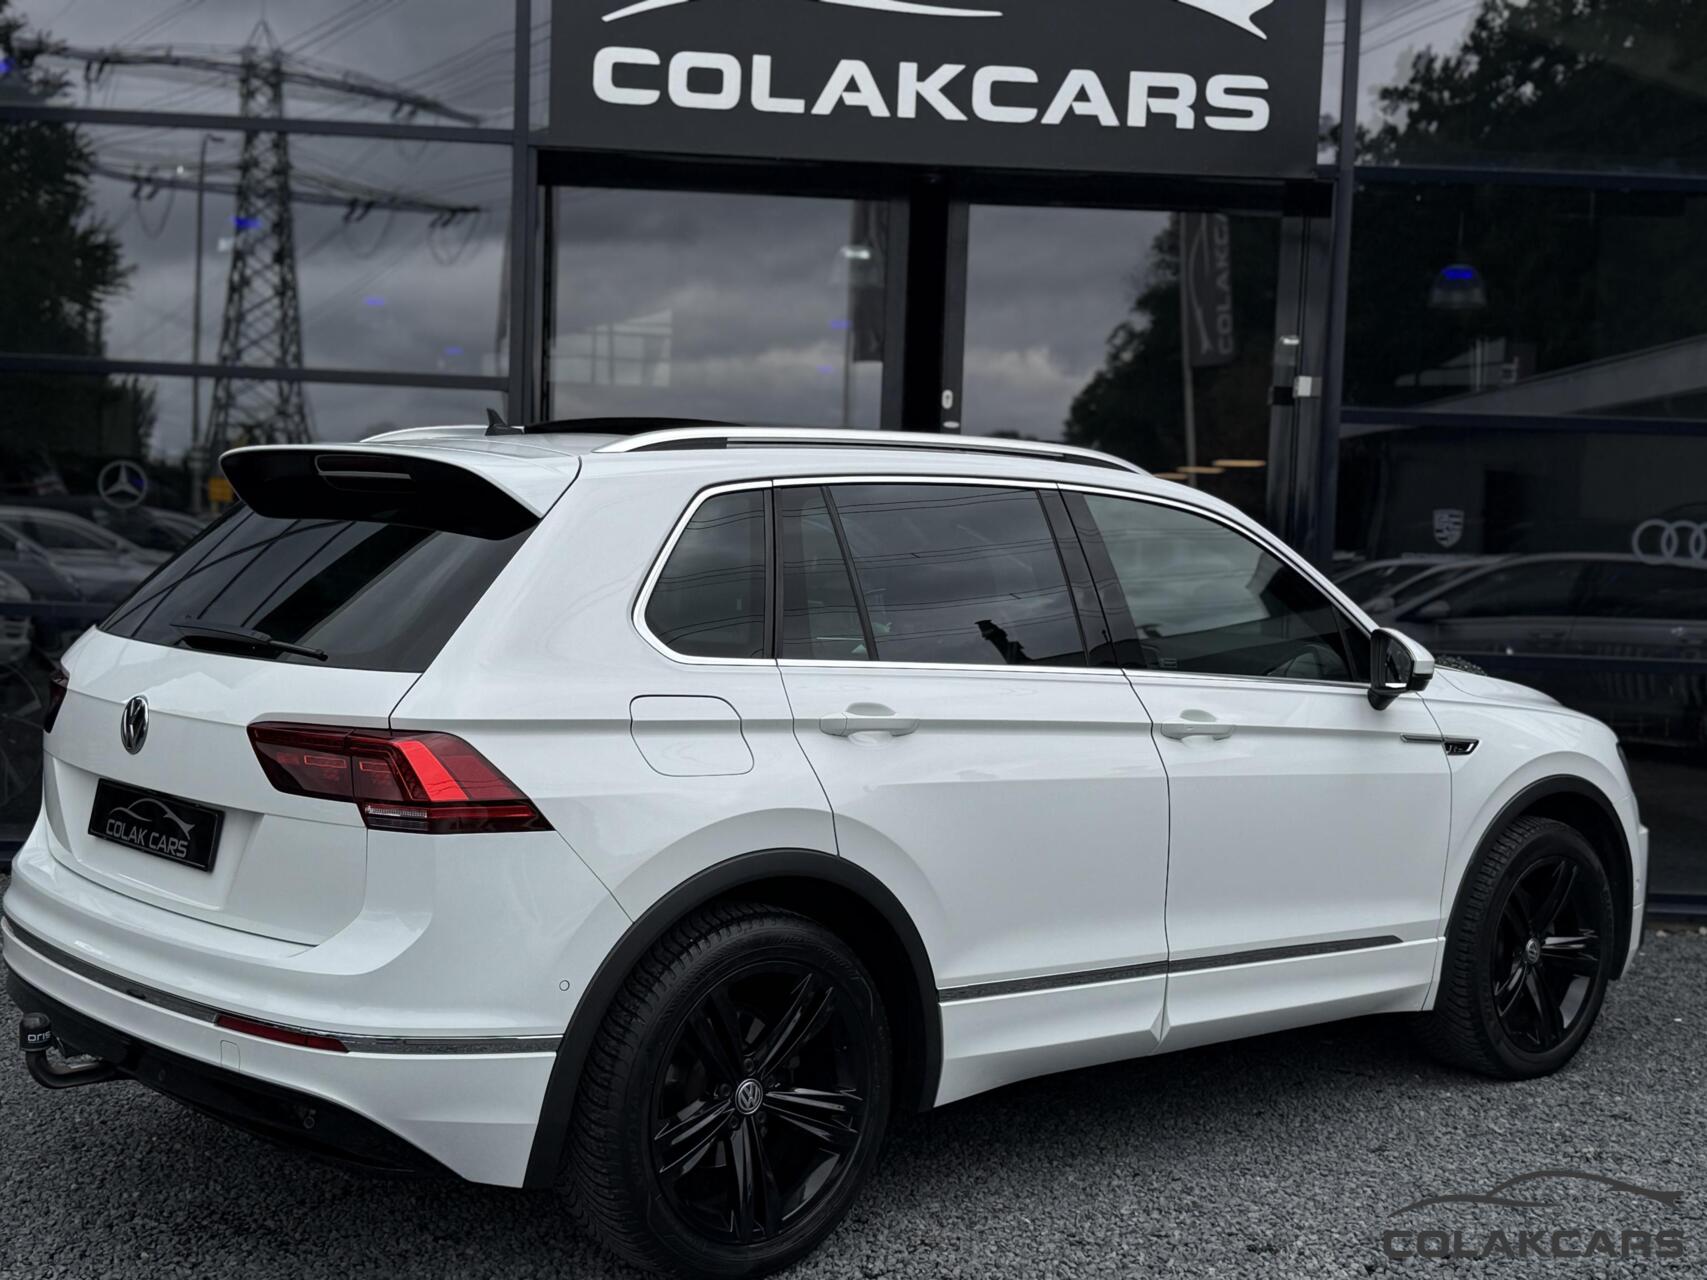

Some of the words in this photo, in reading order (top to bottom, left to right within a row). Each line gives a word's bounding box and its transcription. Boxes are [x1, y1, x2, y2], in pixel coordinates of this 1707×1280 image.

[592, 46, 1271, 132] COLAKCARS
[106, 819, 148, 846] COLAK
[149, 832, 189, 858] CARS
